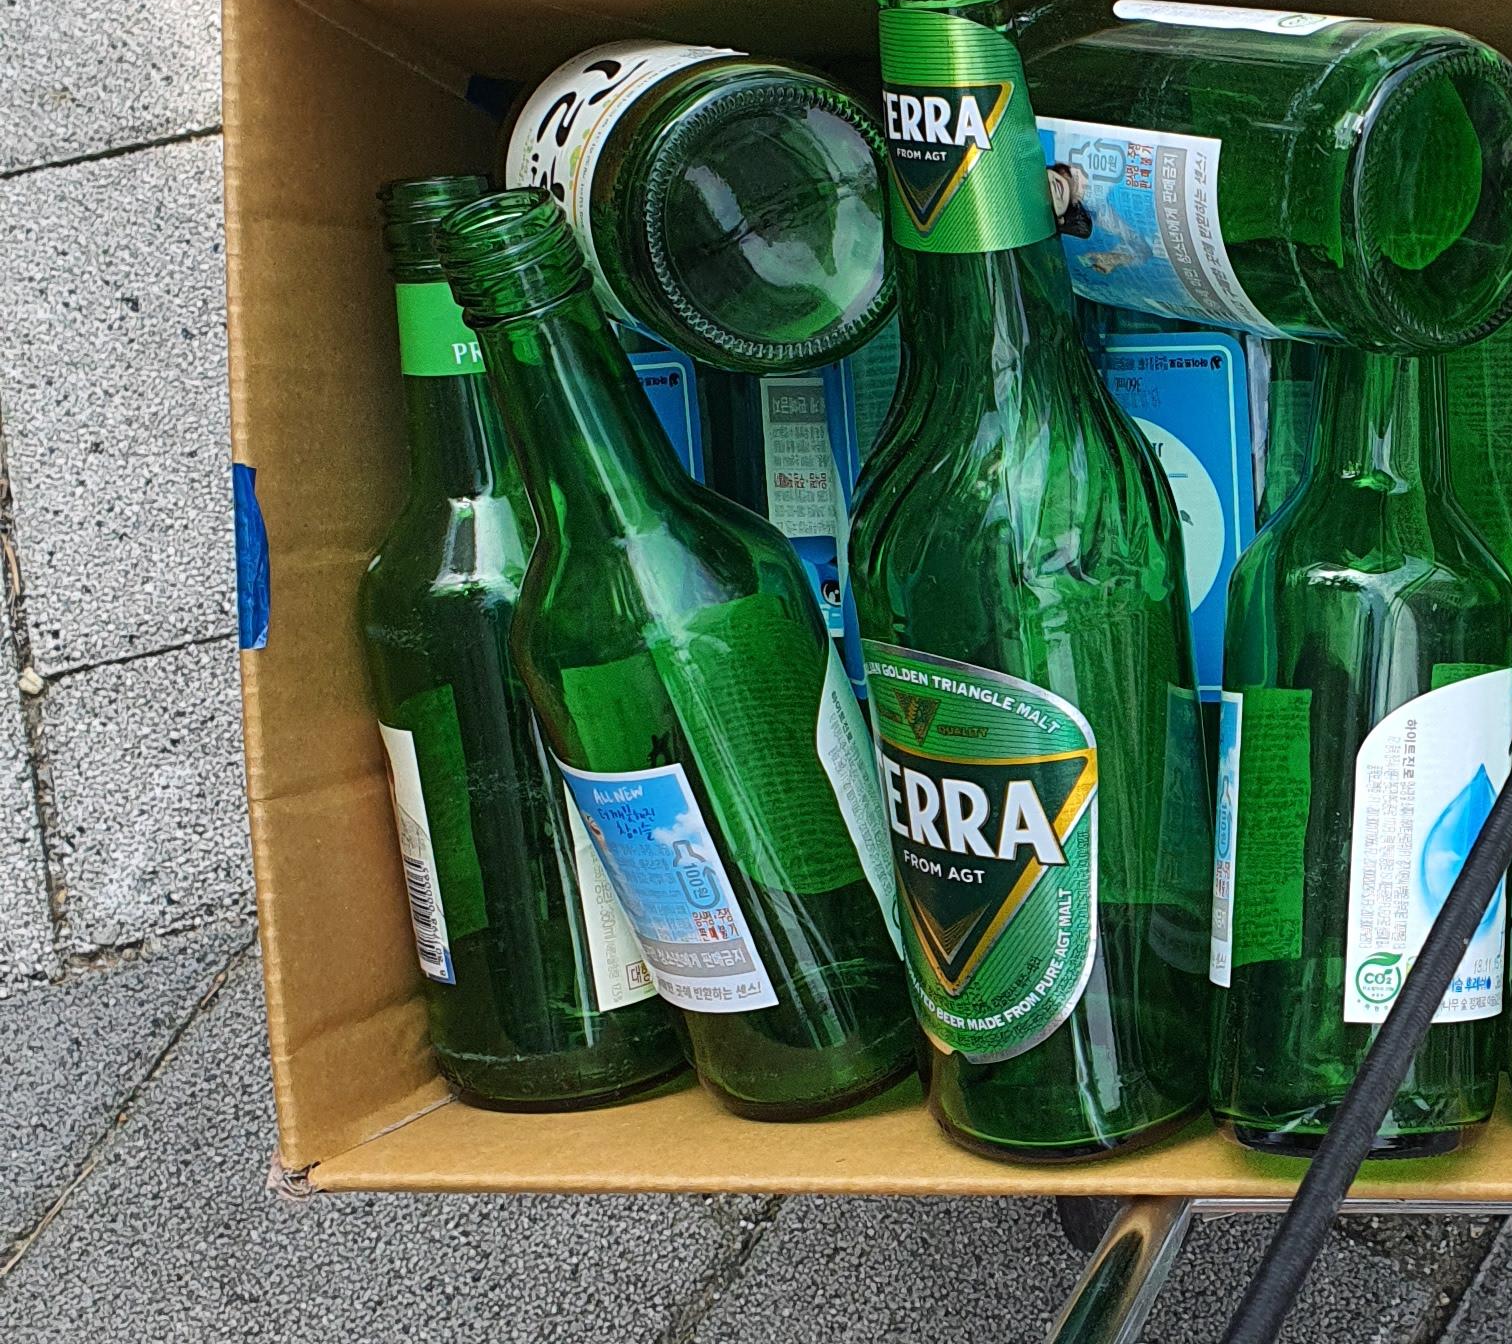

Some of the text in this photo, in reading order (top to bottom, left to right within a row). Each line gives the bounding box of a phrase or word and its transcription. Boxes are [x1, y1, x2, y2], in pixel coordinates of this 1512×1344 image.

[882, 90, 992, 150] ERRA
[896, 147, 948, 162] FROM AGT
[881, 663, 928, 687] GOLDEN
[931, 675, 1016, 712] TRIANGLE
[1016, 702, 1061, 735] MALT
[1403, 718, 1419, 779] 하이트진로
[593, 784, 644, 805] ALL NEW
[877, 748, 1067, 865] ERRA
[684, 862, 711, 900] 100원
[903, 849, 985, 885] FROM AGT
[702, 949, 747, 968] 판매금지
[936, 887, 1074, 1032] BEER MADE FROM PURE AGT MALT
